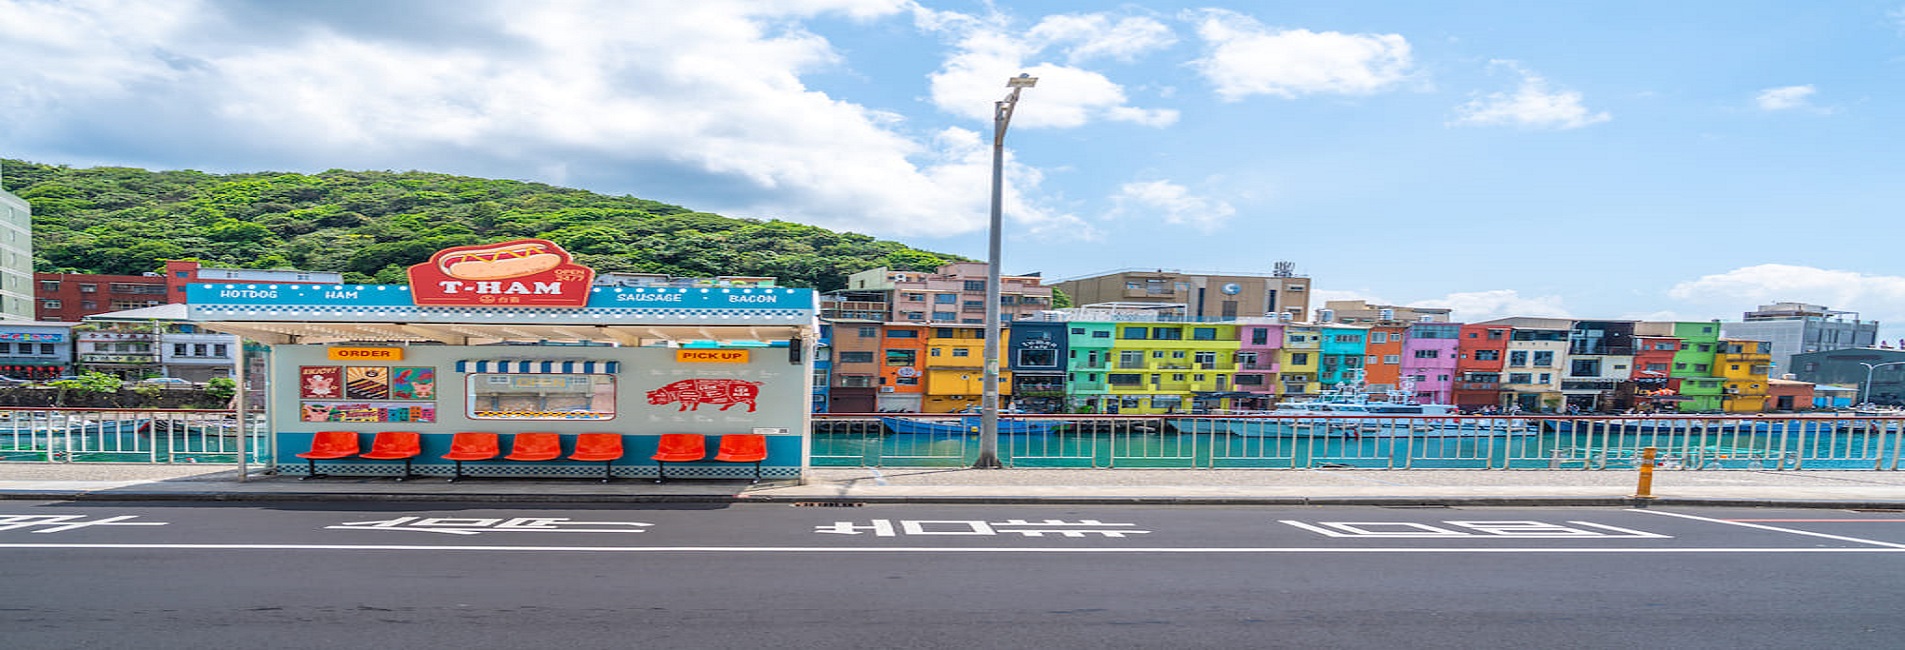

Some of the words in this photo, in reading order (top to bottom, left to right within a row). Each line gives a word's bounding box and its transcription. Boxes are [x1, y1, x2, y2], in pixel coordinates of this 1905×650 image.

[439, 281, 562, 295] T-HAM
[220, 289, 278, 299] HOTDOG
[325, 290, 358, 299] HAM
[616, 293, 682, 303] SAUSAGE
[729, 294, 777, 303] BACON
[338, 349, 390, 358] ORDER
[682, 352, 718, 360] PICK
[516, 377, 566, 387] OPEN
